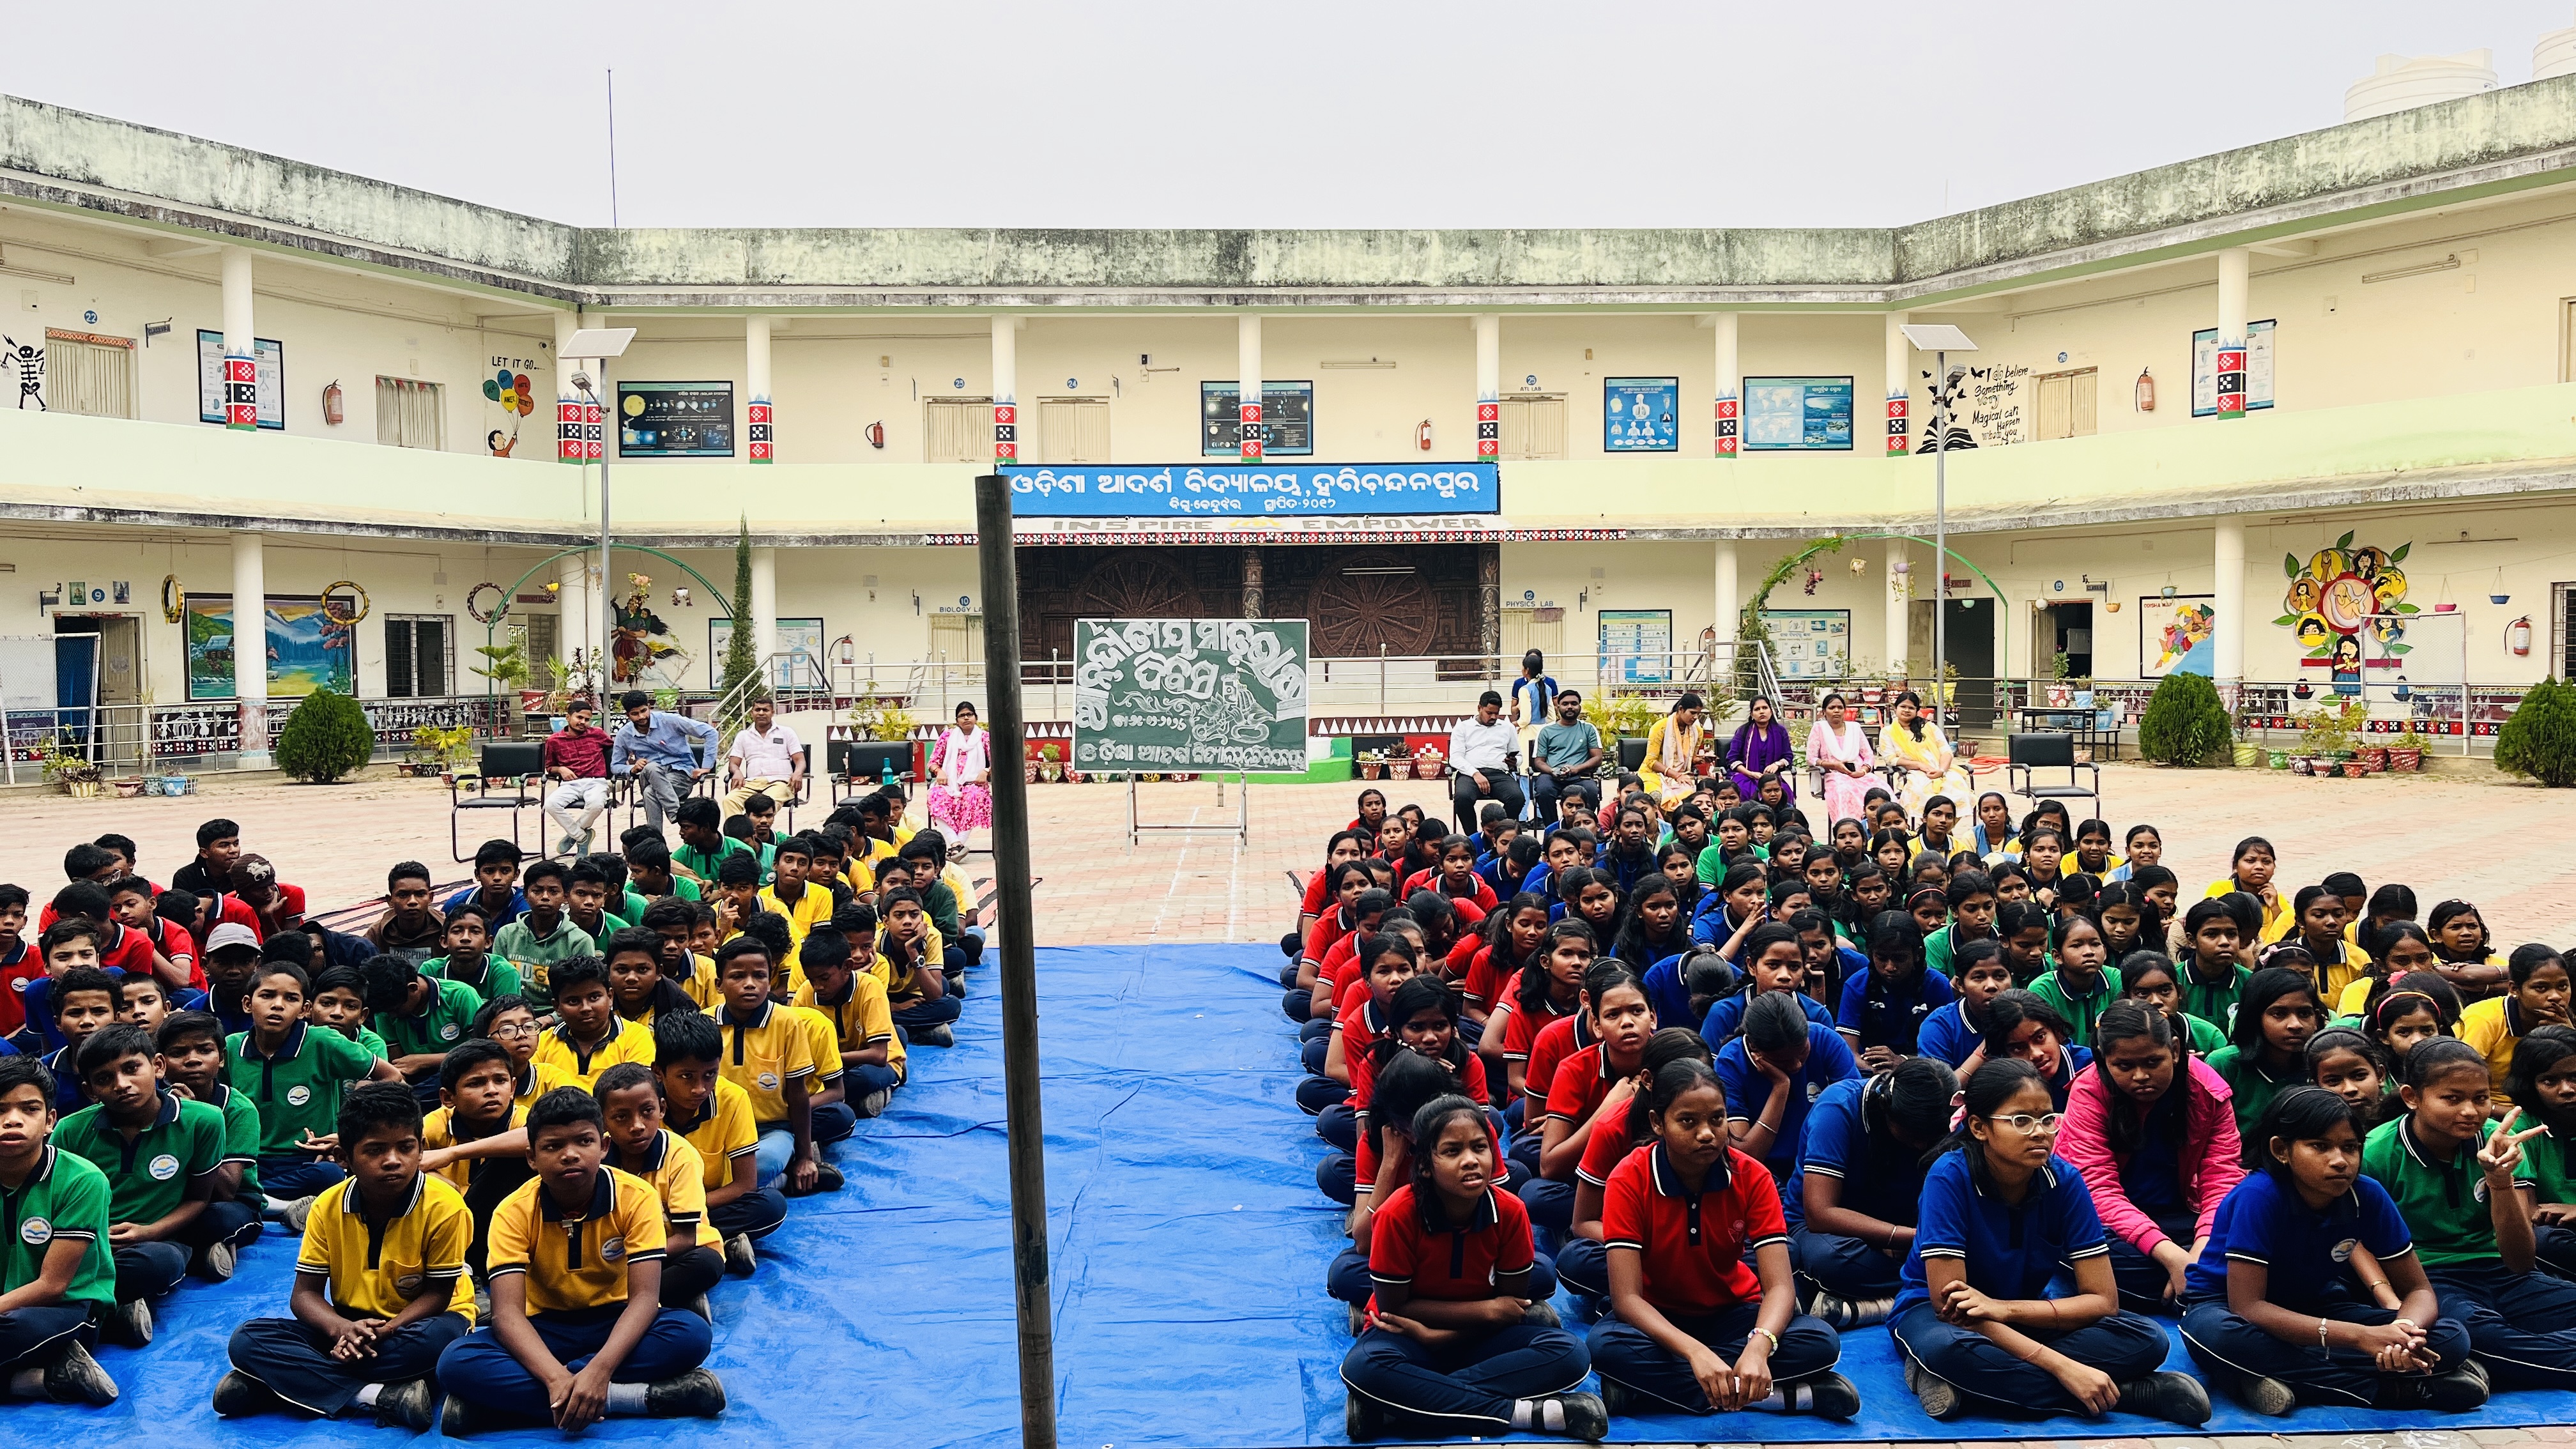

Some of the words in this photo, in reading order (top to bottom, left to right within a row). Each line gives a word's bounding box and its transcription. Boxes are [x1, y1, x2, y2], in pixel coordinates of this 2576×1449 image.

[84, 312, 97, 323] 22
[492, 355, 508, 367] LET
[513, 358, 521, 368] IT
[1987, 368, 1992, 382] I
[1993, 364, 2004, 381] do
[1068, 379, 1077, 388] 24
[1972, 410, 2002, 427] Magical
[2005, 405, 2018, 418] can
[1997, 417, 2020, 431] Happen
[2005, 429, 2018, 440] you
[1010, 470, 1085, 498] ଓଡ଼ିଶା
[1097, 467, 1172, 494] ଆଦର୍ଶ
[1302, 519, 1485, 530] EMPOWER
